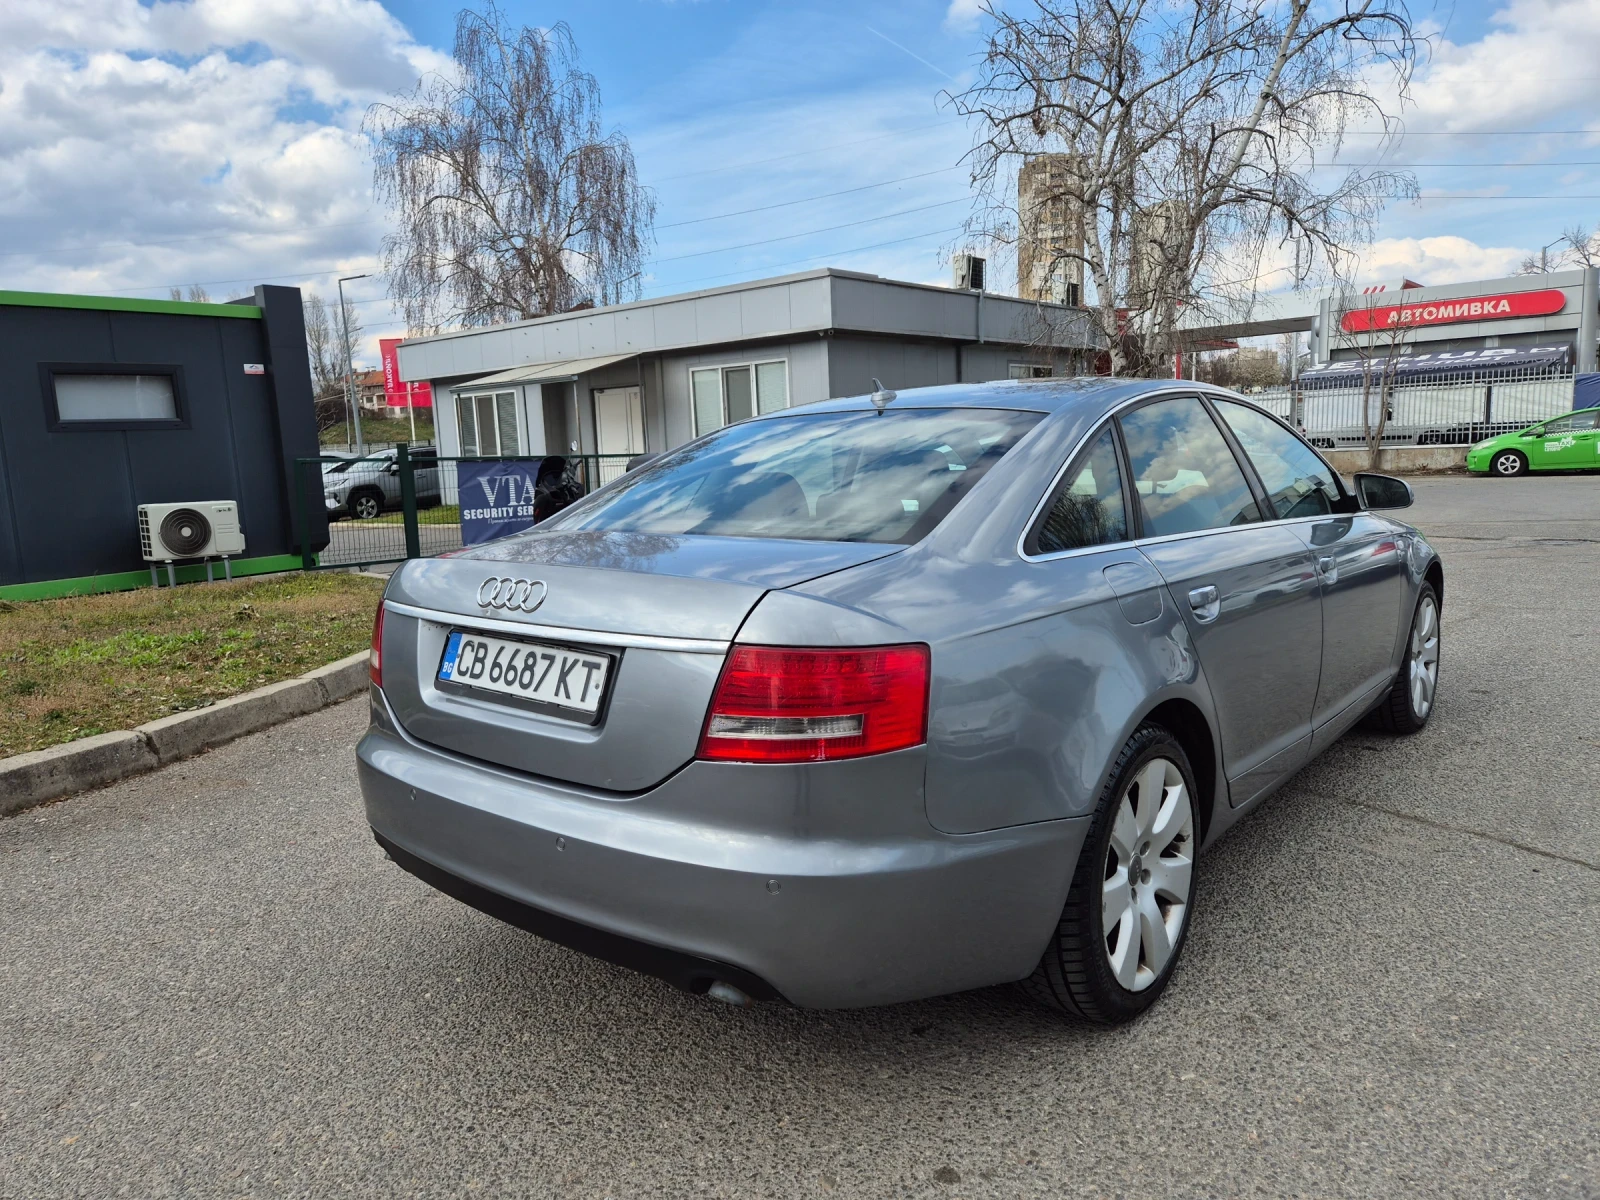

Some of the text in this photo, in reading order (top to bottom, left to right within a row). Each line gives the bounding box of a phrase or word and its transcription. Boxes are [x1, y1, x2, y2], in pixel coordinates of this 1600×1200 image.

[1387, 299, 1511, 324] АВТОМИВКА
[477, 474, 535, 507] VTA
[463, 507, 514, 520] SECURITY
[442, 661, 454, 674] BG
